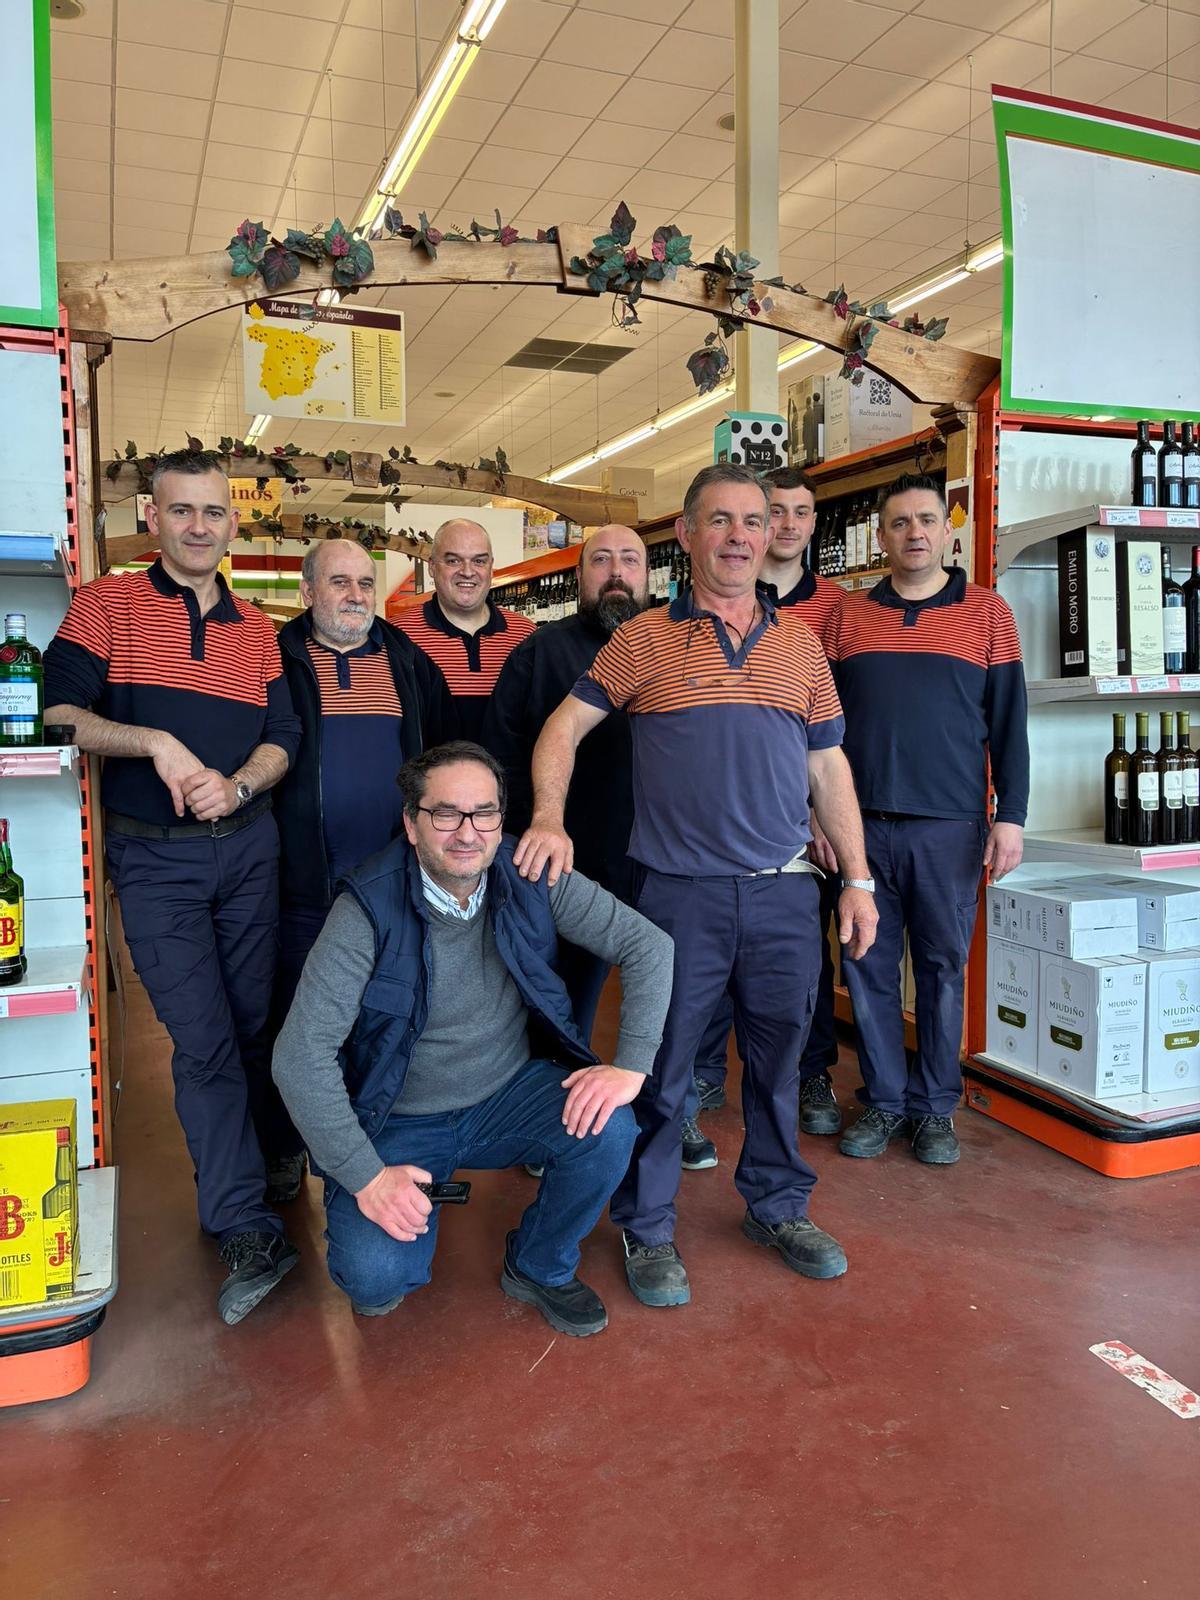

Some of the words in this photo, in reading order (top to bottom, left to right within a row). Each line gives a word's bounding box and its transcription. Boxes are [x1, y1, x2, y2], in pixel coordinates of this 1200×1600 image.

[269, 302, 289, 315] Mapa
[290, 304, 298, 314] de
[232, 485, 273, 501] inos
[1067, 550, 1078, 593] EMILIO
[1069, 595, 1079, 634] MORO
[997, 981, 1029, 998] MIUDIÑO
[1049, 1000, 1085, 1018] MIUDIÑO
[1108, 998, 1138, 1009] MIUDIÑO
[1163, 1004, 1200, 1016] MIUDIÑO
[1, 1253, 31, 1265] OTTLES
